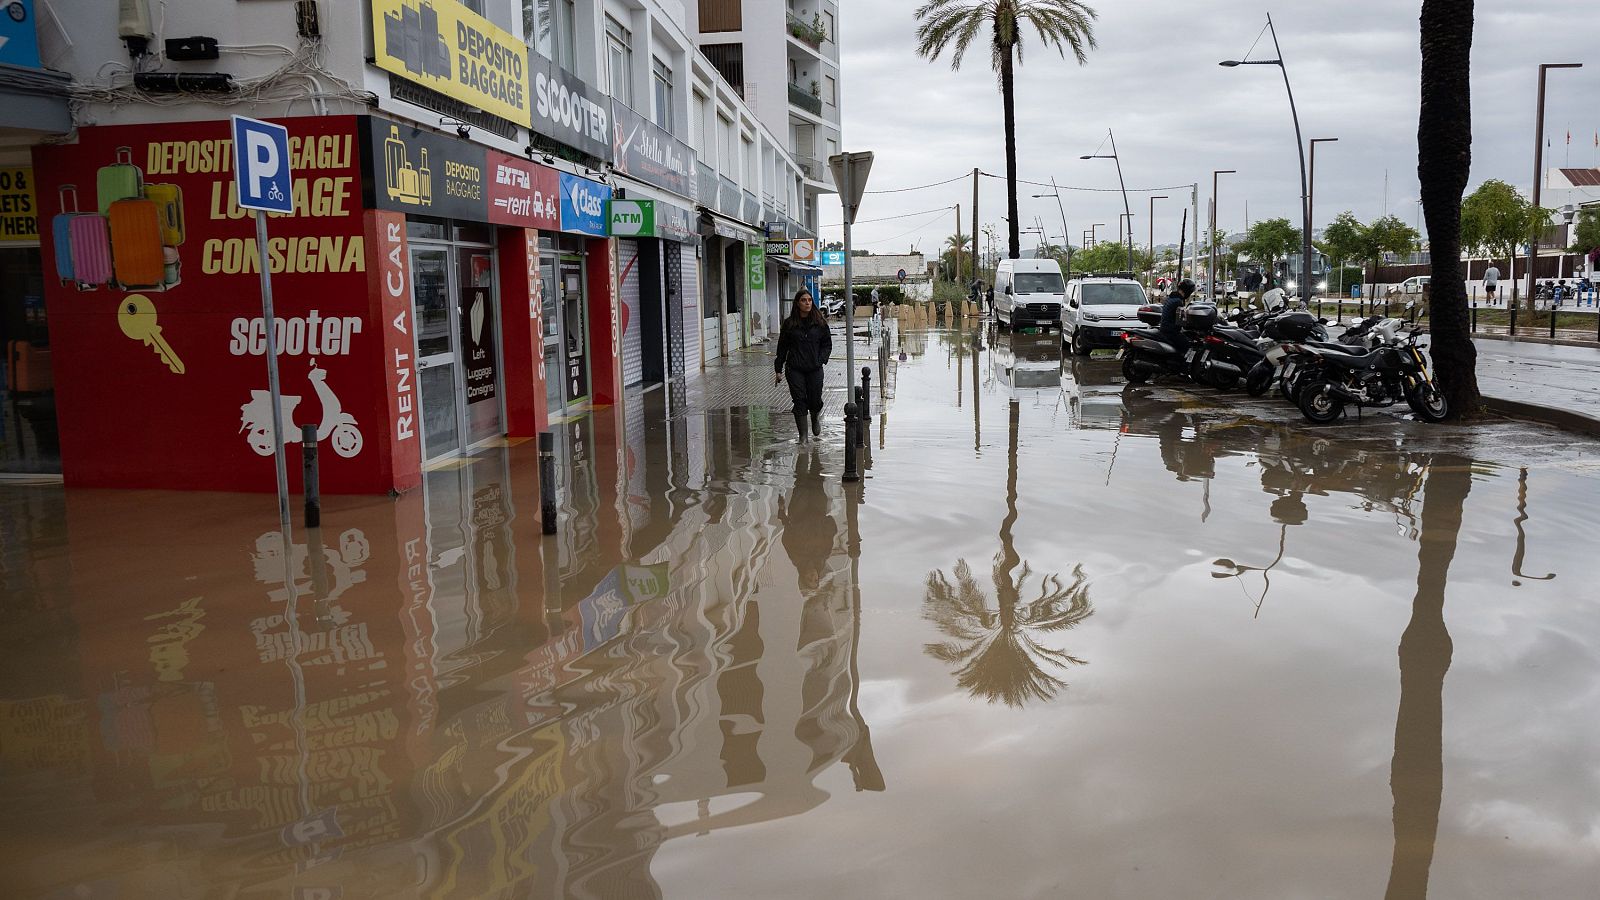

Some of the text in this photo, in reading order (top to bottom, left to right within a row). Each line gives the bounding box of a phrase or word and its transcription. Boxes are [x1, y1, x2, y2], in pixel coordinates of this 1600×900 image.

[457, 19, 522, 80] DEPOSITO
[458, 53, 524, 110] BAGGAGE
[535, 72, 608, 146] SCOOTER
[147, 134, 353, 175] DEPOSIT GAGLI
[246, 129, 280, 198] P
[15, 171, 26, 190] &
[445, 160, 480, 182] DEPOSITO
[495, 164, 531, 190] EXTRA
[0, 194, 31, 213] ETS
[446, 179, 480, 200] BAGGAGE
[507, 195, 530, 217] rent
[612, 213, 641, 223] ATM
[202, 235, 366, 275] CONSIGNA
[751, 254, 763, 285] CAR
[528, 238, 537, 319] RENT
[533, 236, 546, 380] SCOOTER
[229, 309, 362, 356] scooter
[387, 222, 414, 441] RENT A CAR
[472, 348, 486, 360] Left
[467, 366, 492, 381] Luggage
[467, 382, 494, 398] Consigna
